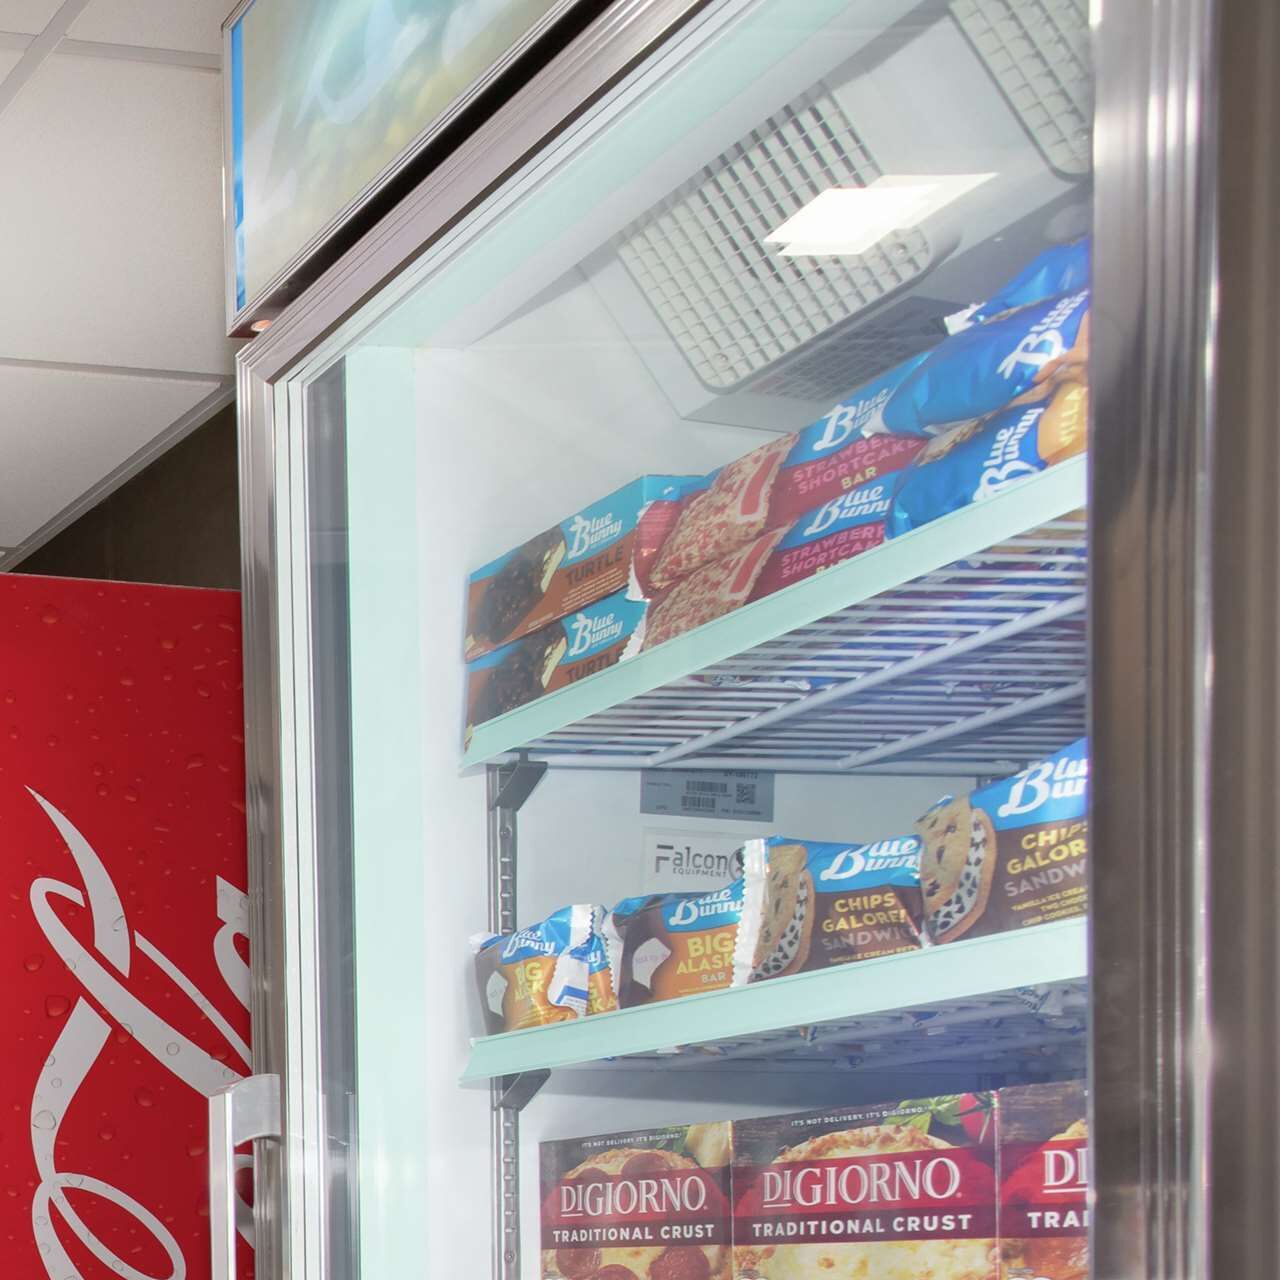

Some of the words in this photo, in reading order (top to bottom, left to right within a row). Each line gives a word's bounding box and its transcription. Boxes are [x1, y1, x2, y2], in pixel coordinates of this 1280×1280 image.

[813, 388, 889, 451] Blue
[841, 466, 878, 490] BAR
[565, 545, 624, 586] TURTLE
[655, 844, 728, 873] Falcon
[1007, 838, 1088, 875] GALOR
[673, 868, 727, 877] EQUIPMENT
[834, 892, 896, 913] CHIPS
[822, 908, 906, 933] GALORE!
[686, 932, 734, 958] BIG
[701, 972, 726, 984] BAR
[791, 1119, 805, 1127] IT'S
[865, 1111, 881, 1119] IT'S
[763, 1157, 960, 1208] DIGIORNO
[561, 1175, 706, 1217] DIGIORNO
[553, 1226, 654, 1242] TRADITIONAL
[660, 1224, 715, 1239] CRUST
[753, 1217, 885, 1237] TRADITIONAL
[892, 1214, 972, 1232] CRUST
